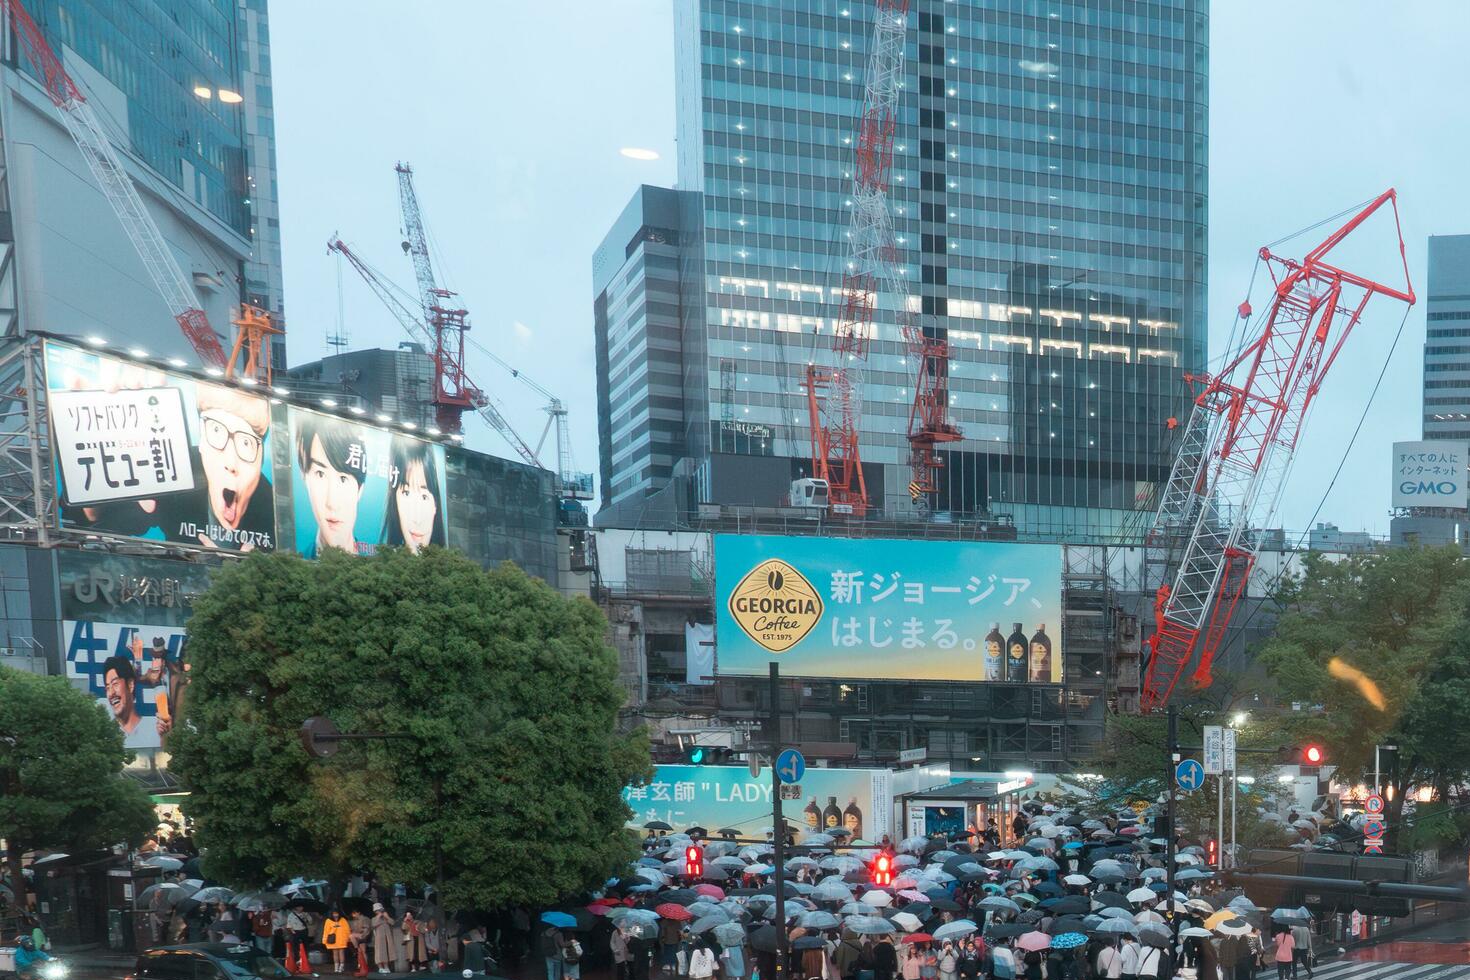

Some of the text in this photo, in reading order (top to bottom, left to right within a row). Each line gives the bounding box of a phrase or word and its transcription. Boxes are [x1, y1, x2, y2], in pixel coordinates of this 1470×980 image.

[68, 404, 138, 433] ソフトバンク
[75, 438, 177, 491] デビュー割
[1400, 453, 1458, 463] すべての人に
[1399, 466, 1456, 476] インターネット
[1400, 481, 1456, 494] GMO
[75, 567, 118, 609] JR
[120, 575, 182, 608] 渋谷駅
[830, 569, 1042, 609] 新ジョージア、
[736, 597, 817, 615] GEORGIA
[753, 615, 801, 633] Coffee
[831, 616, 976, 650] はじまる。
[777, 633, 793, 641] 1975
